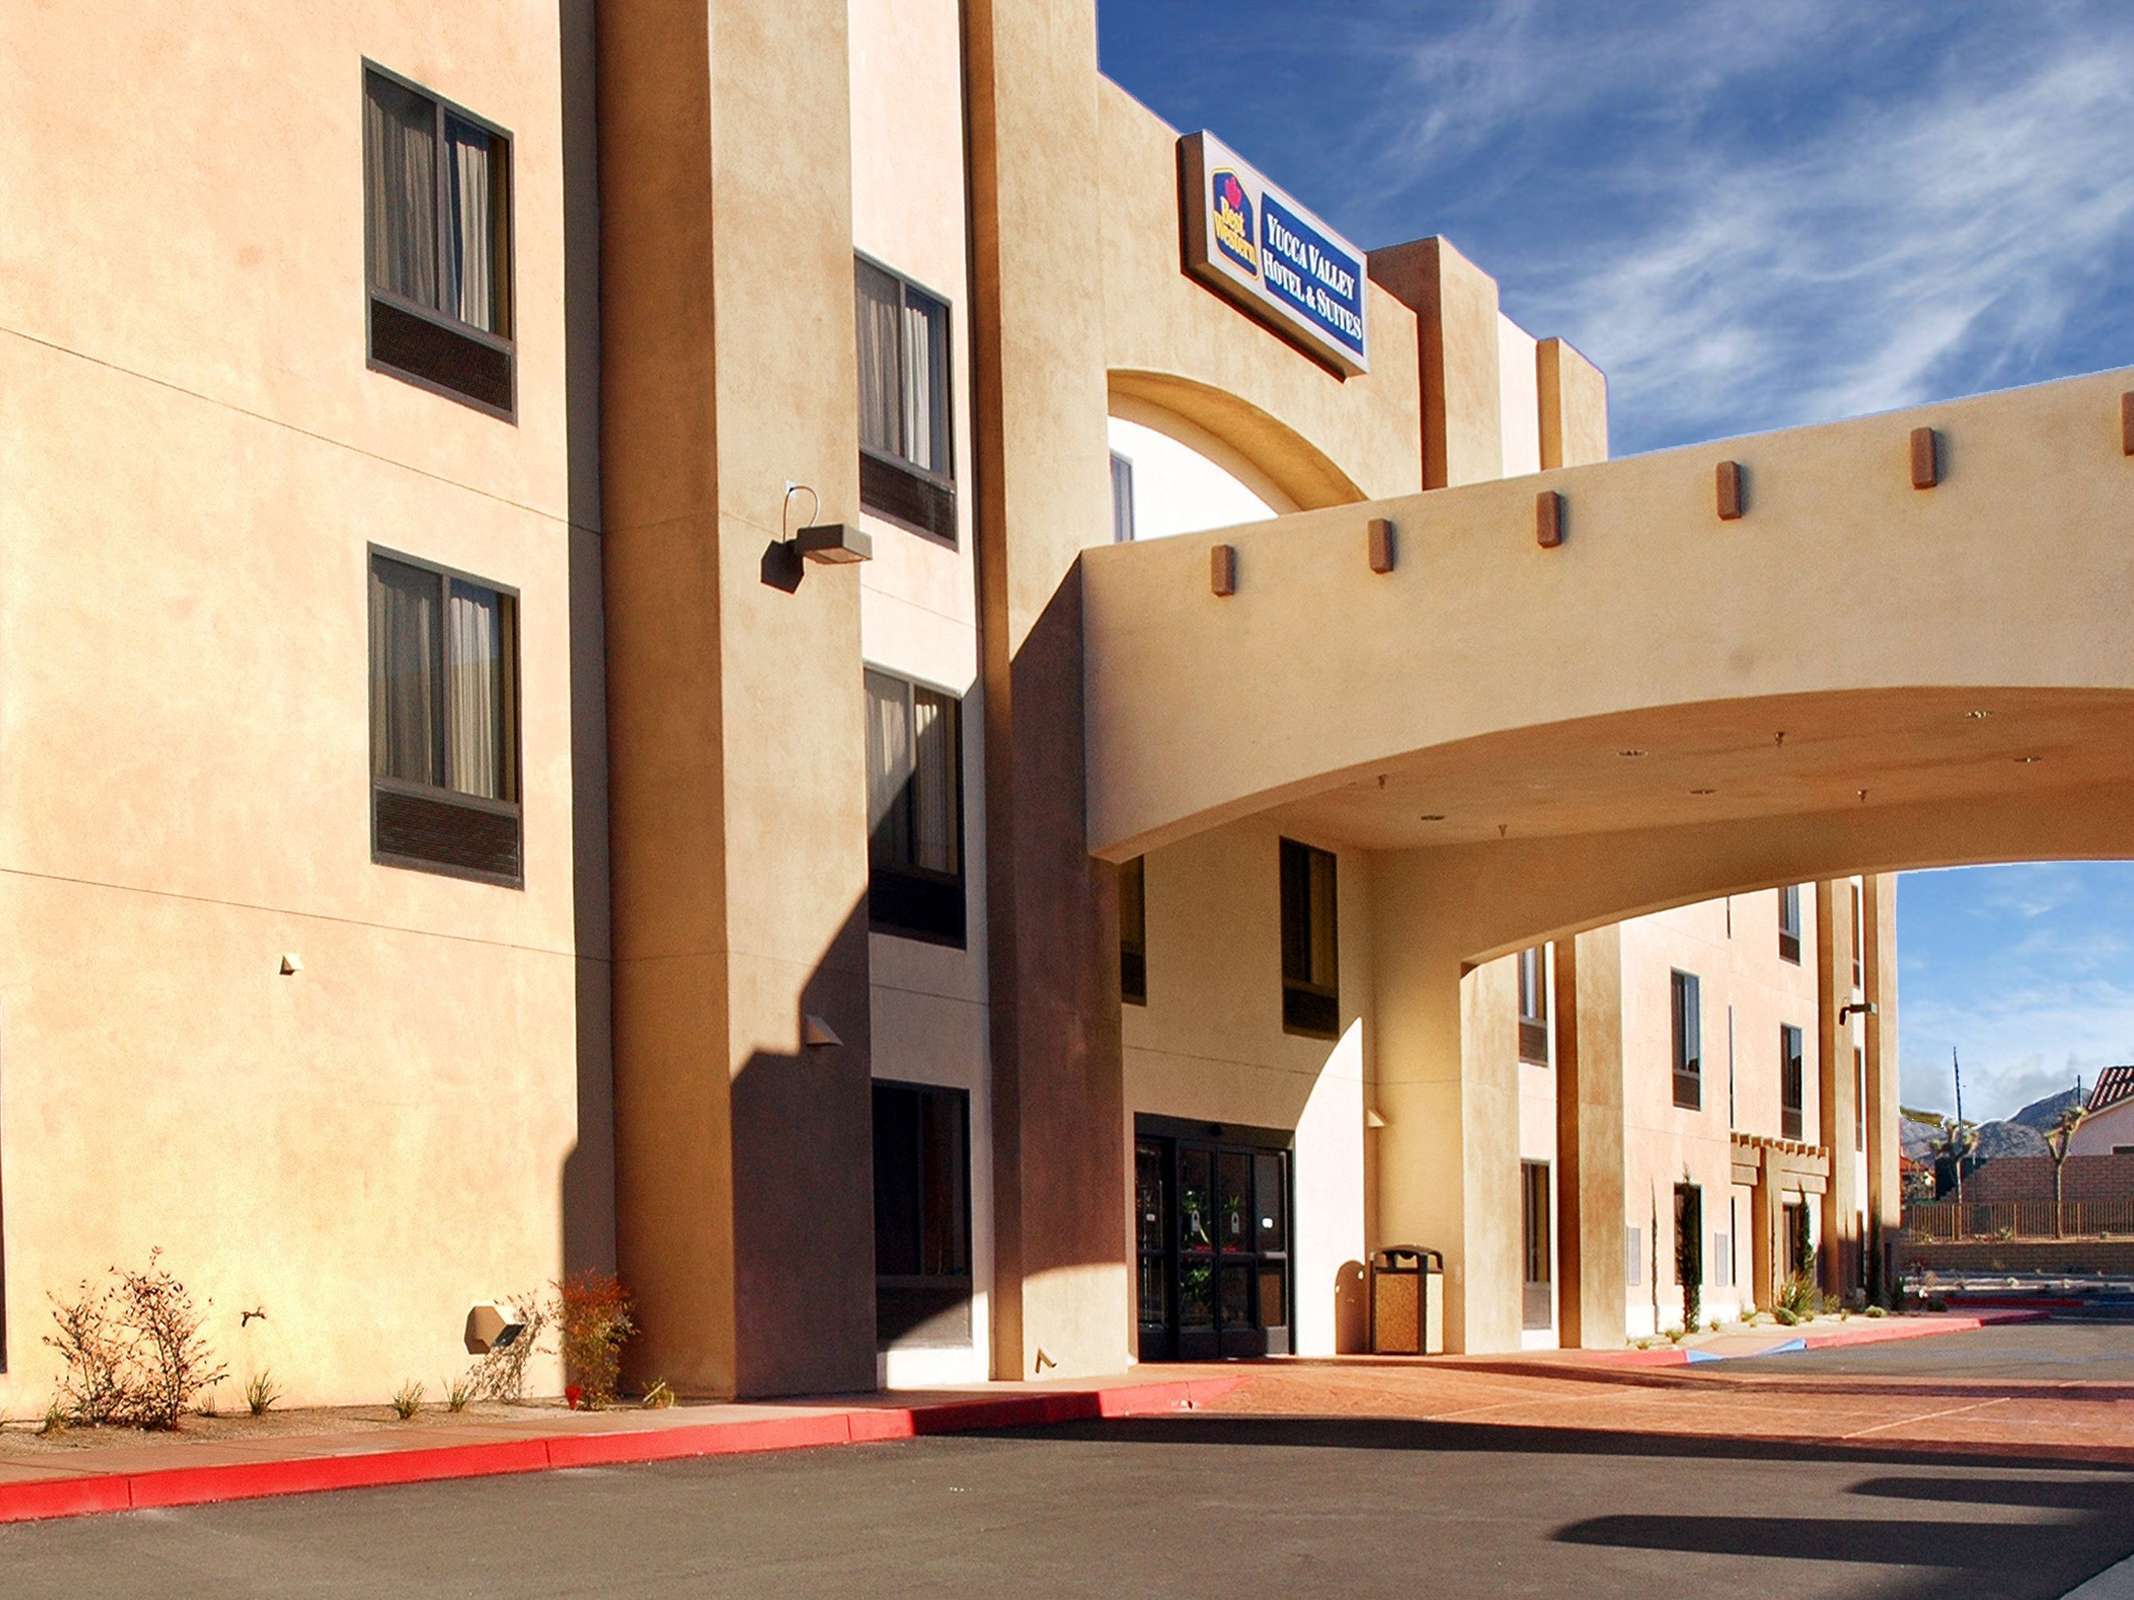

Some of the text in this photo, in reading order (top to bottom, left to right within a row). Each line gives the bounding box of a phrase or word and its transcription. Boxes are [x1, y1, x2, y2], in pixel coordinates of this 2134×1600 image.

[1262, 248, 1361, 340] HOTEL & SUITES
[1267, 213, 1355, 300] YUCCA VALLEY
